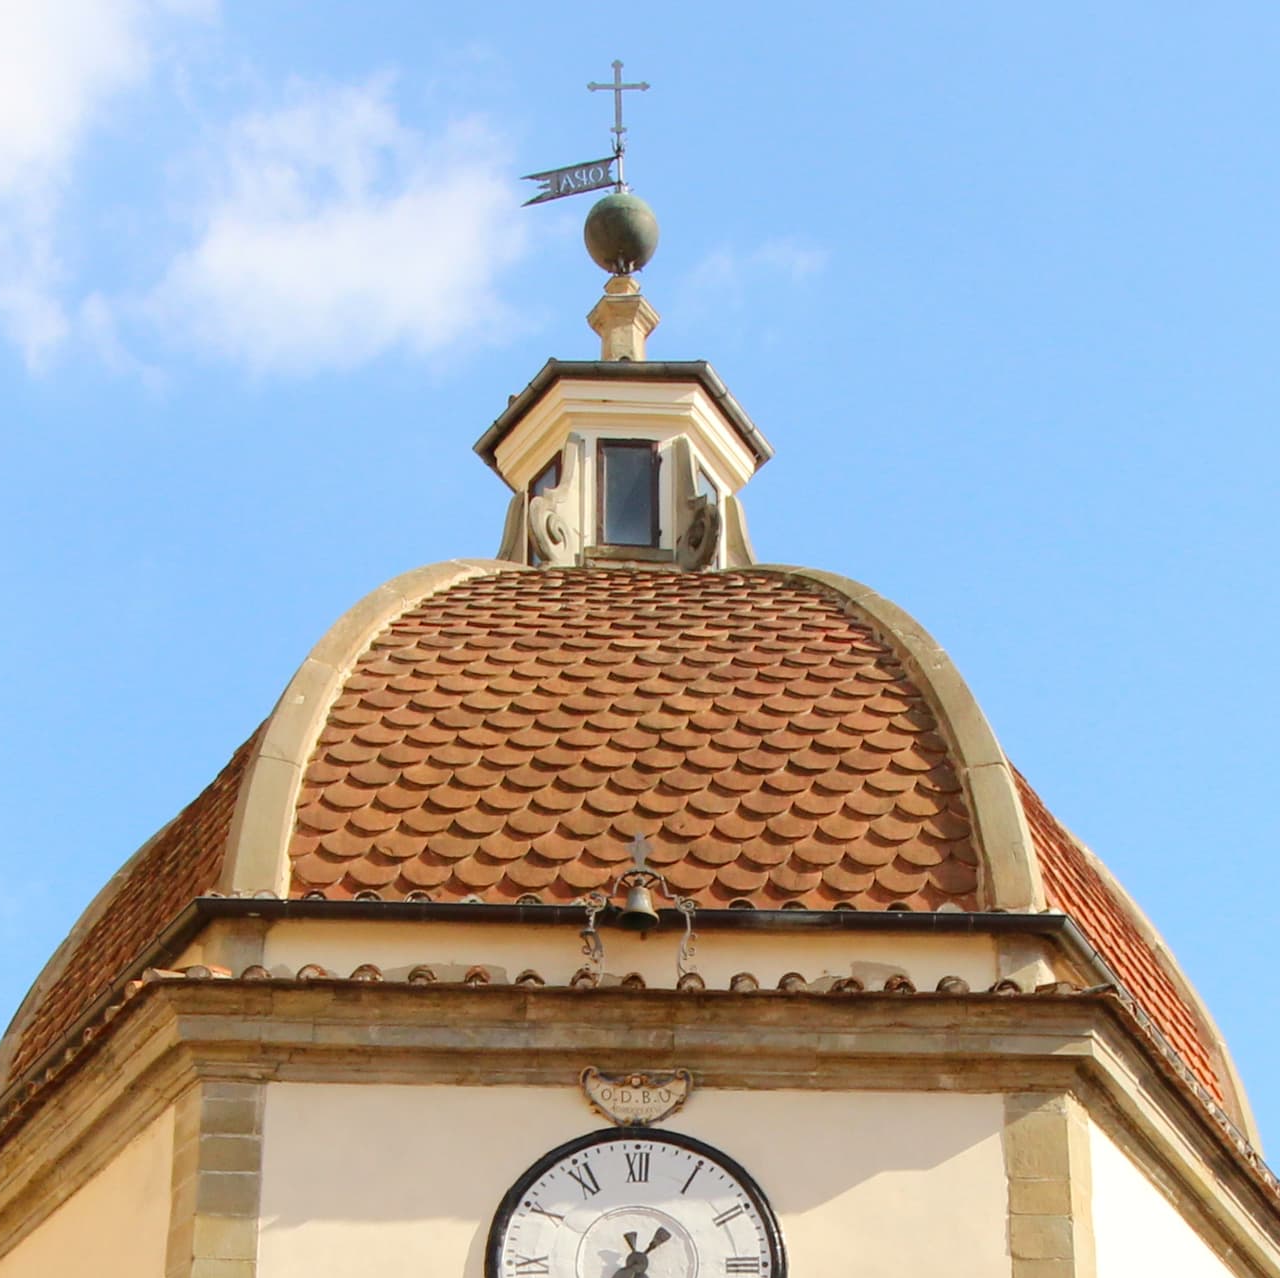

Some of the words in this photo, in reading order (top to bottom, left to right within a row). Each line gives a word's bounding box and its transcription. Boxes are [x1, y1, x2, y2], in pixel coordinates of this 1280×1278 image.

[568, 1161, 601, 1200] XI
[625, 1151, 650, 1183] XII
[681, 1164, 701, 1195] I
[530, 1200, 565, 1228] X
[712, 1203, 744, 1228] II
[515, 1254, 549, 1276] IX
[725, 1256, 760, 1274] III
